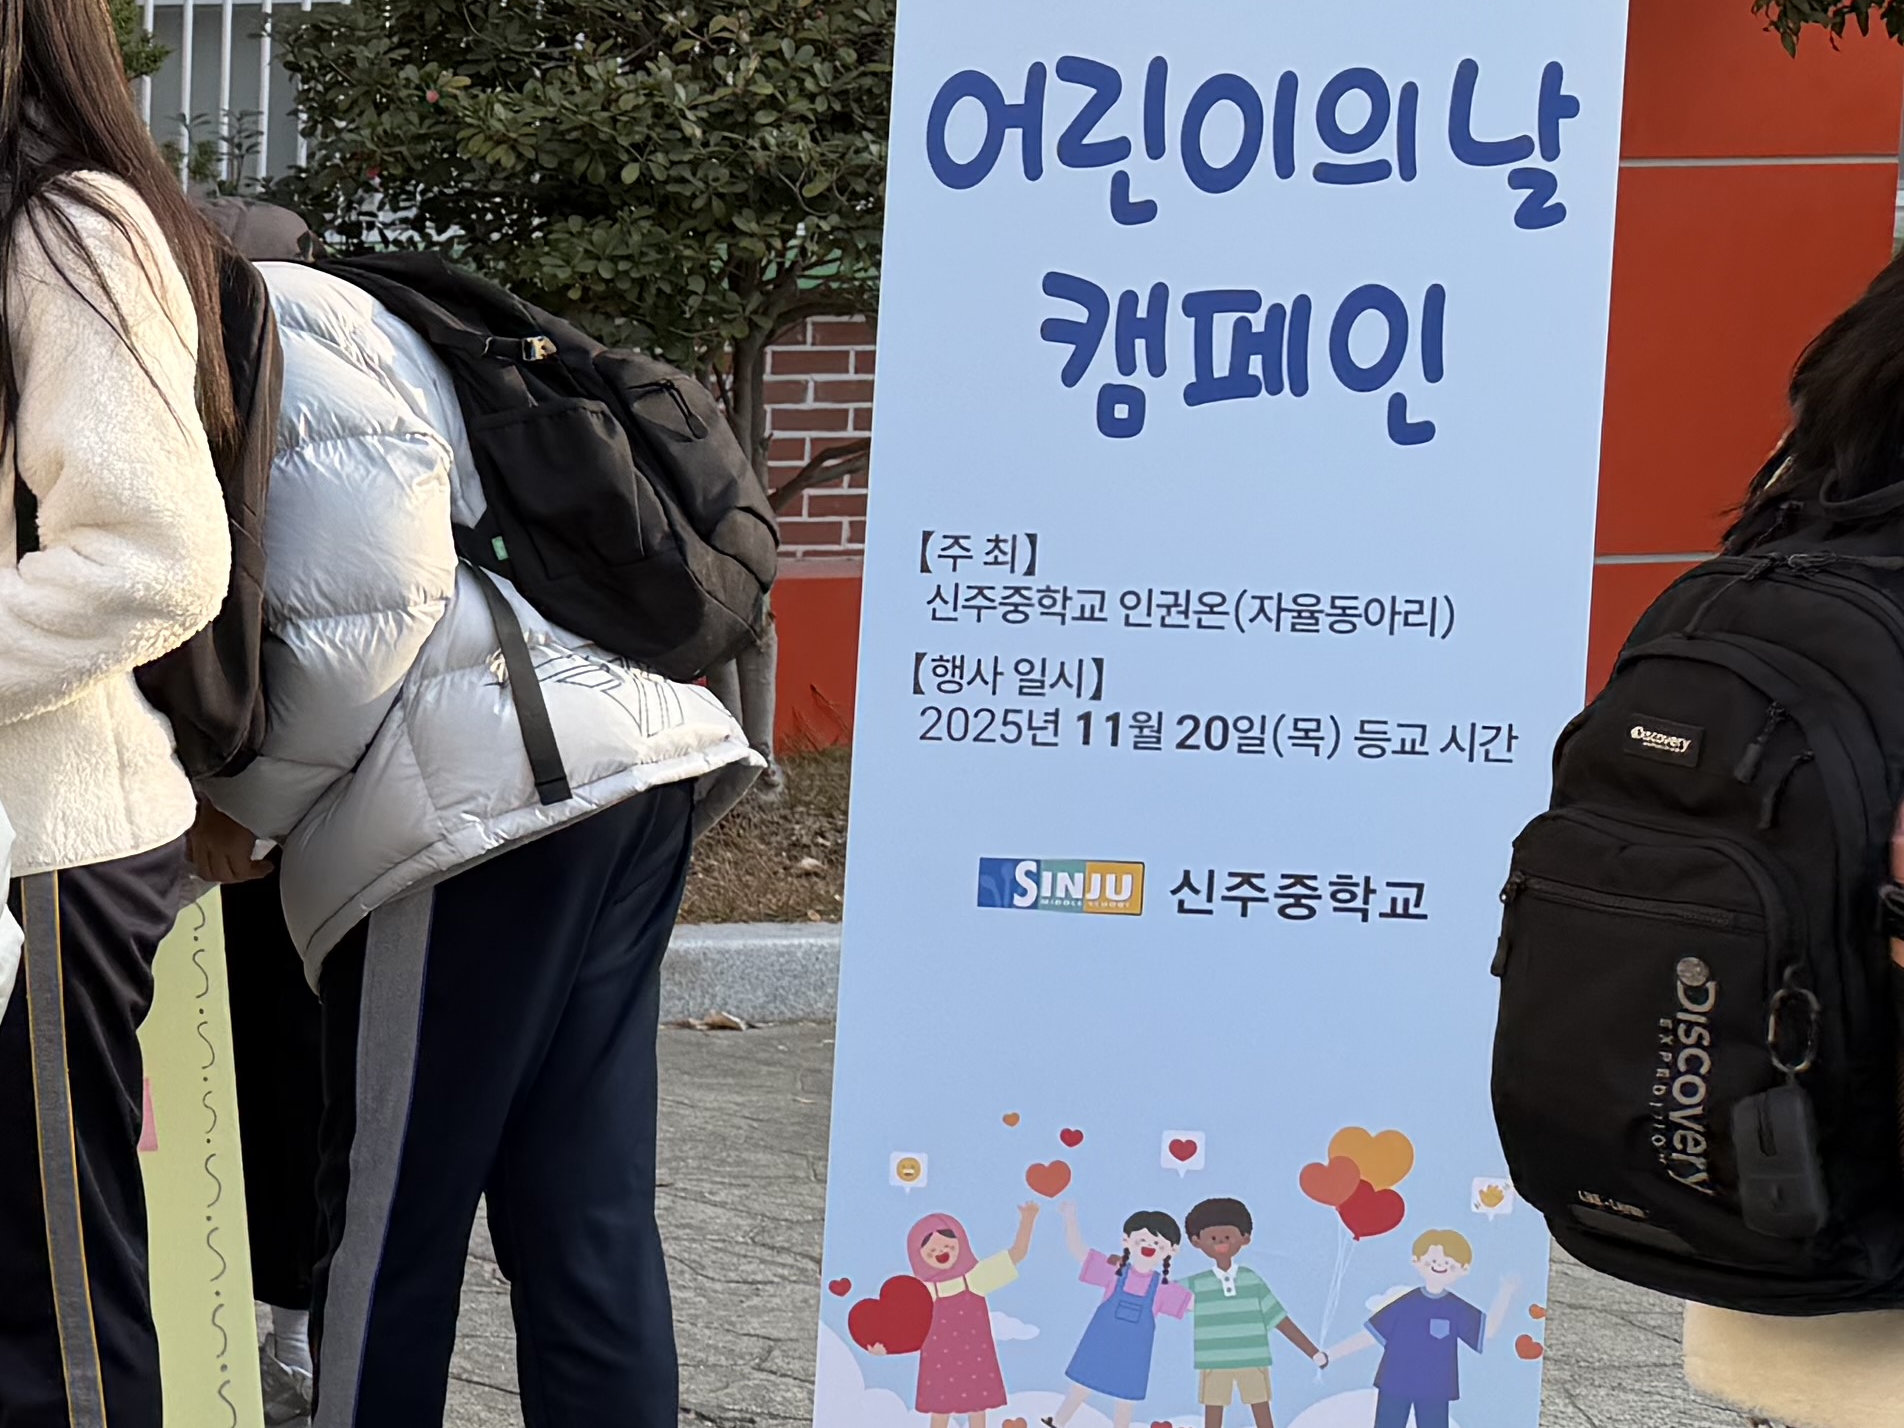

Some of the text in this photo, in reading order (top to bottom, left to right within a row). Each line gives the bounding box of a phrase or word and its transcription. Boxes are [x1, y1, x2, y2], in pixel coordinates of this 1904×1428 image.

[1039, 270, 1446, 447] 캠페인
[925, 582, 1109, 626] 신주중학교
[918, 705, 1520, 765] 2025년 11월 20일(목) 등교 시간
[1013, 860, 1133, 908] SINJU
[1169, 868, 1430, 923] 신주중학교
